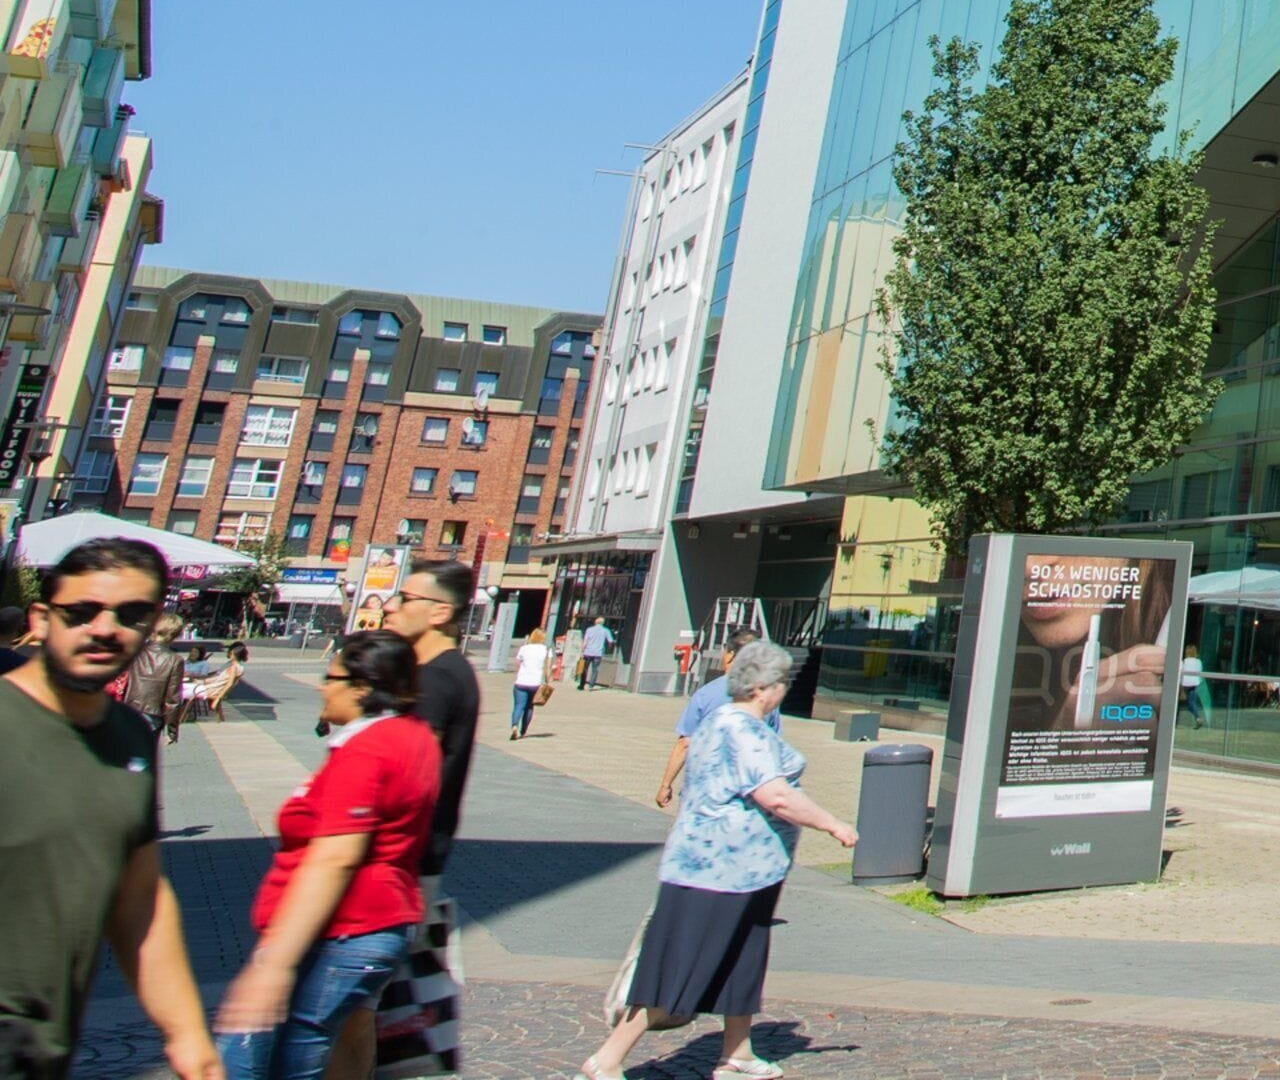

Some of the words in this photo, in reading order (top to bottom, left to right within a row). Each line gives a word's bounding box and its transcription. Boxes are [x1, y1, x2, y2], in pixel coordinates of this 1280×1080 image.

[1030, 565, 1052, 580] 90
[1054, 565, 1065, 580] %
[1069, 565, 1140, 582] WENIGER
[1027, 581, 1142, 600] SCHADSTOFFE
